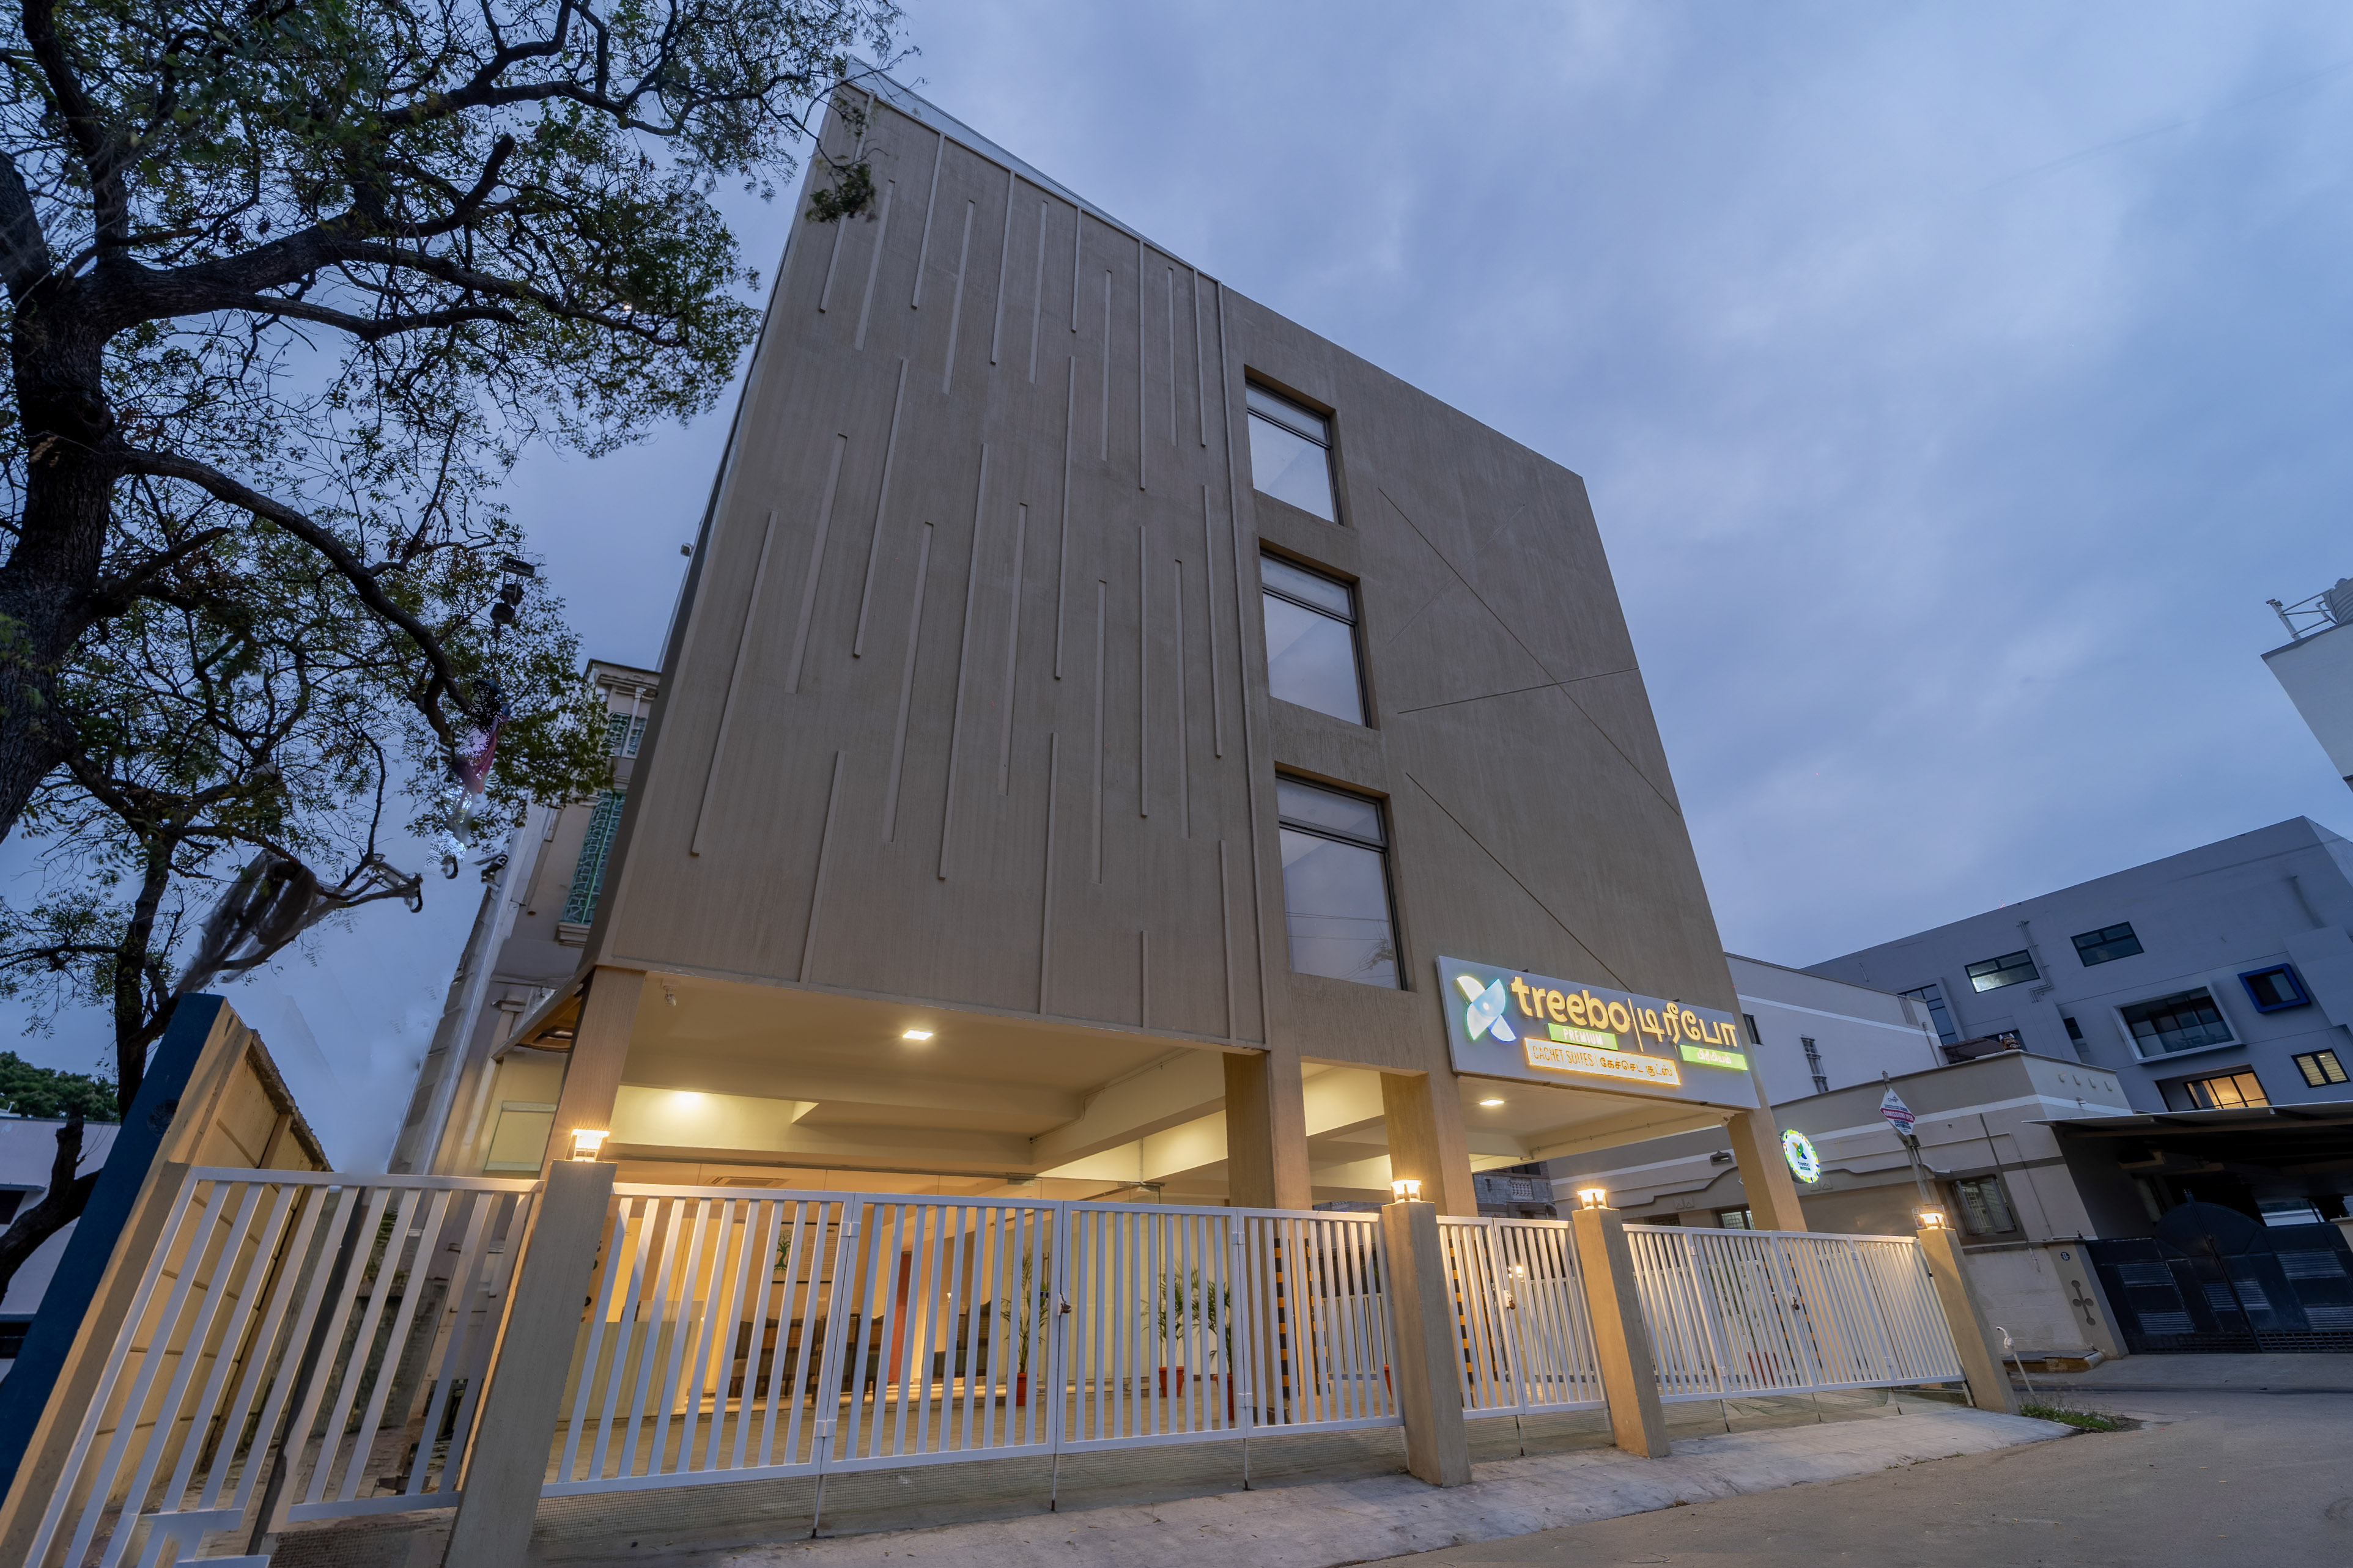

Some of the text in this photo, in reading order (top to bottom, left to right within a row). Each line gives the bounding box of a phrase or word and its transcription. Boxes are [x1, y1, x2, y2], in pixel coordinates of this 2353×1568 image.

[1511, 976, 1630, 1033] treebo
[1563, 1028, 1604, 1046] PREMIUM
[1636, 1002, 1738, 1047] டிரீபோ
[1532, 1045, 1594, 1067] CACHET SUITES
